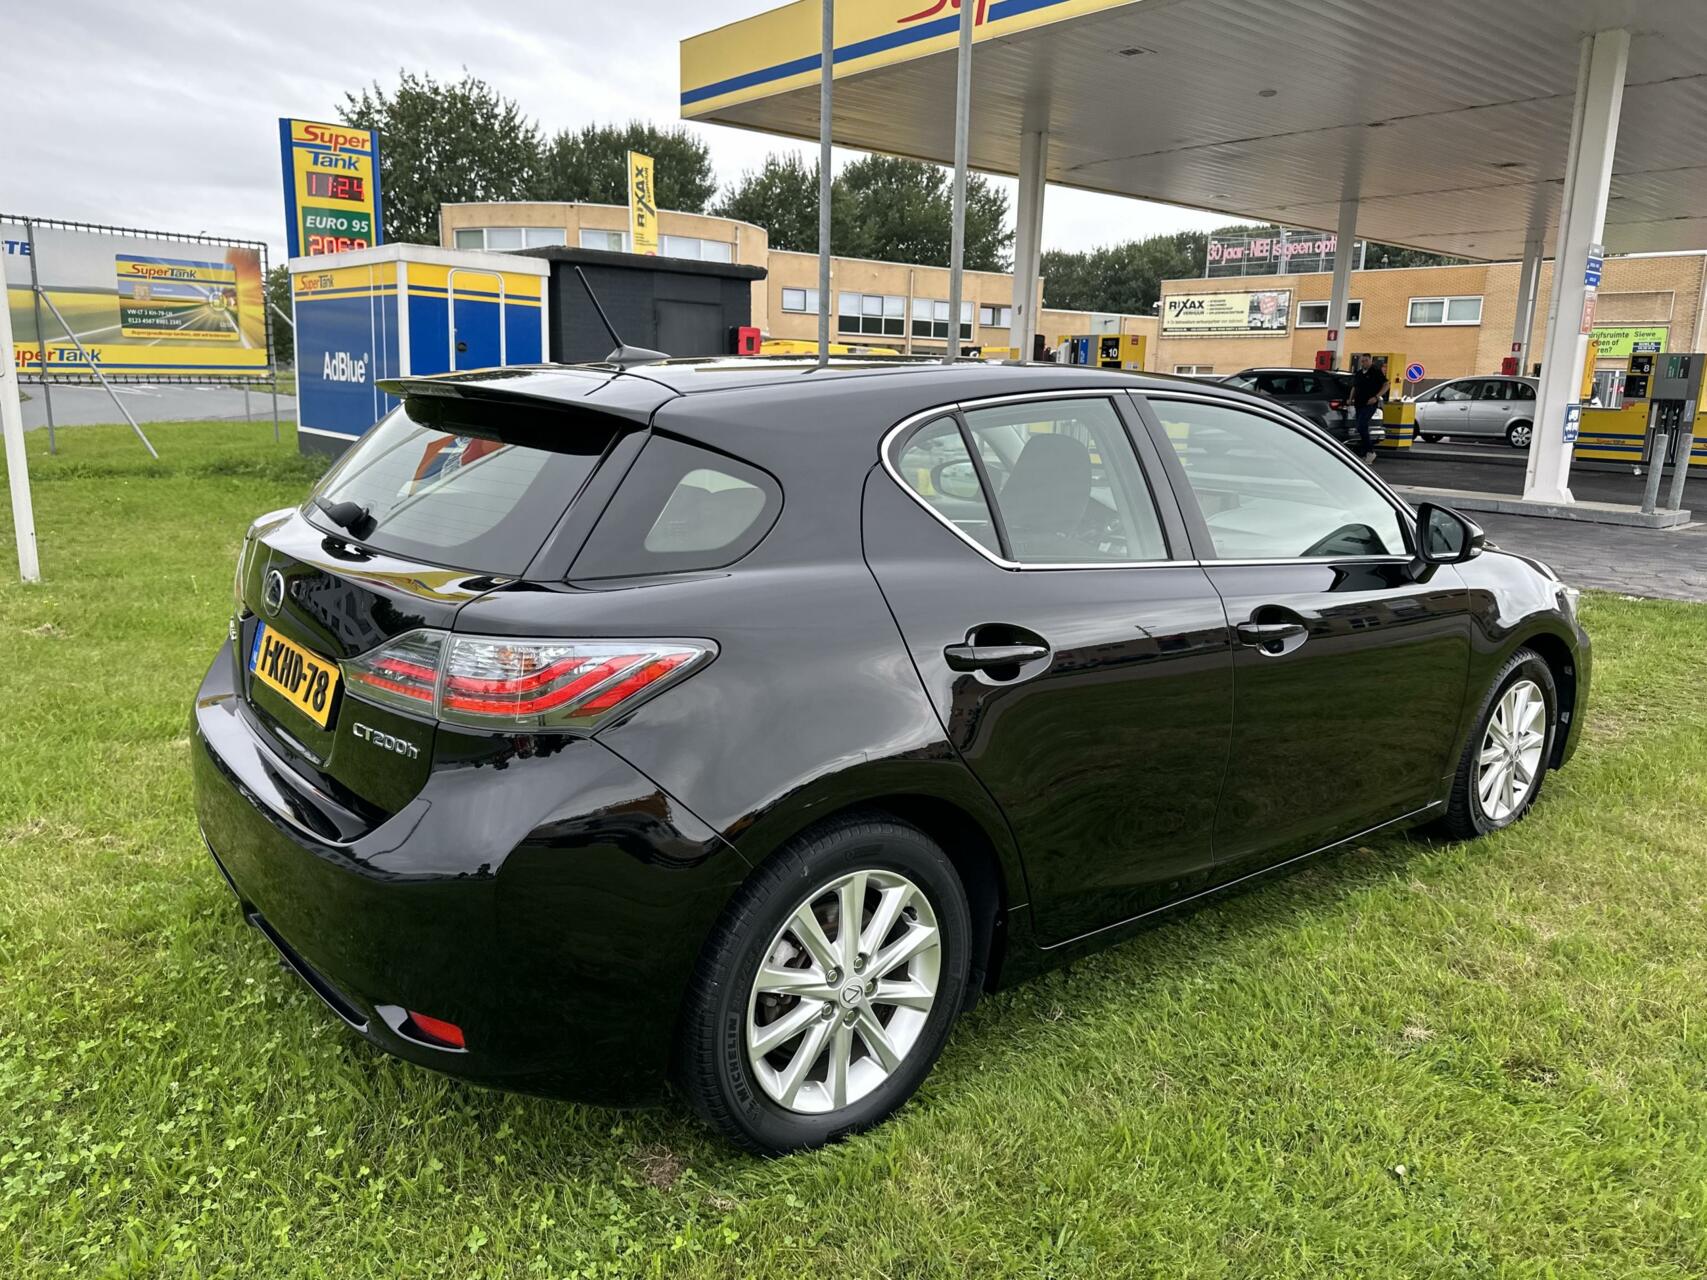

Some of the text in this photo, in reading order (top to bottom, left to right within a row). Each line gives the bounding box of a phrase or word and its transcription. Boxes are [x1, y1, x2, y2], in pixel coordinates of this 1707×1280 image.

[294, 125, 370, 152] Super
[306, 150, 359, 171] Tank
[311, 174, 365, 200] 11:24
[306, 215, 369, 233] EURO 95
[4, 240, 32, 256] TE
[1314, 236, 1338, 260] opti
[127, 263, 198, 279] SuperTank
[1168, 298, 1205, 317] RIXAX
[14, 344, 101, 368] uperTank
[1108, 348, 1118, 357] 10
[1643, 364, 1650, 372] 8
[260, 634, 330, 713] 1-KHD-78
[352, 722, 421, 760] CT200h
